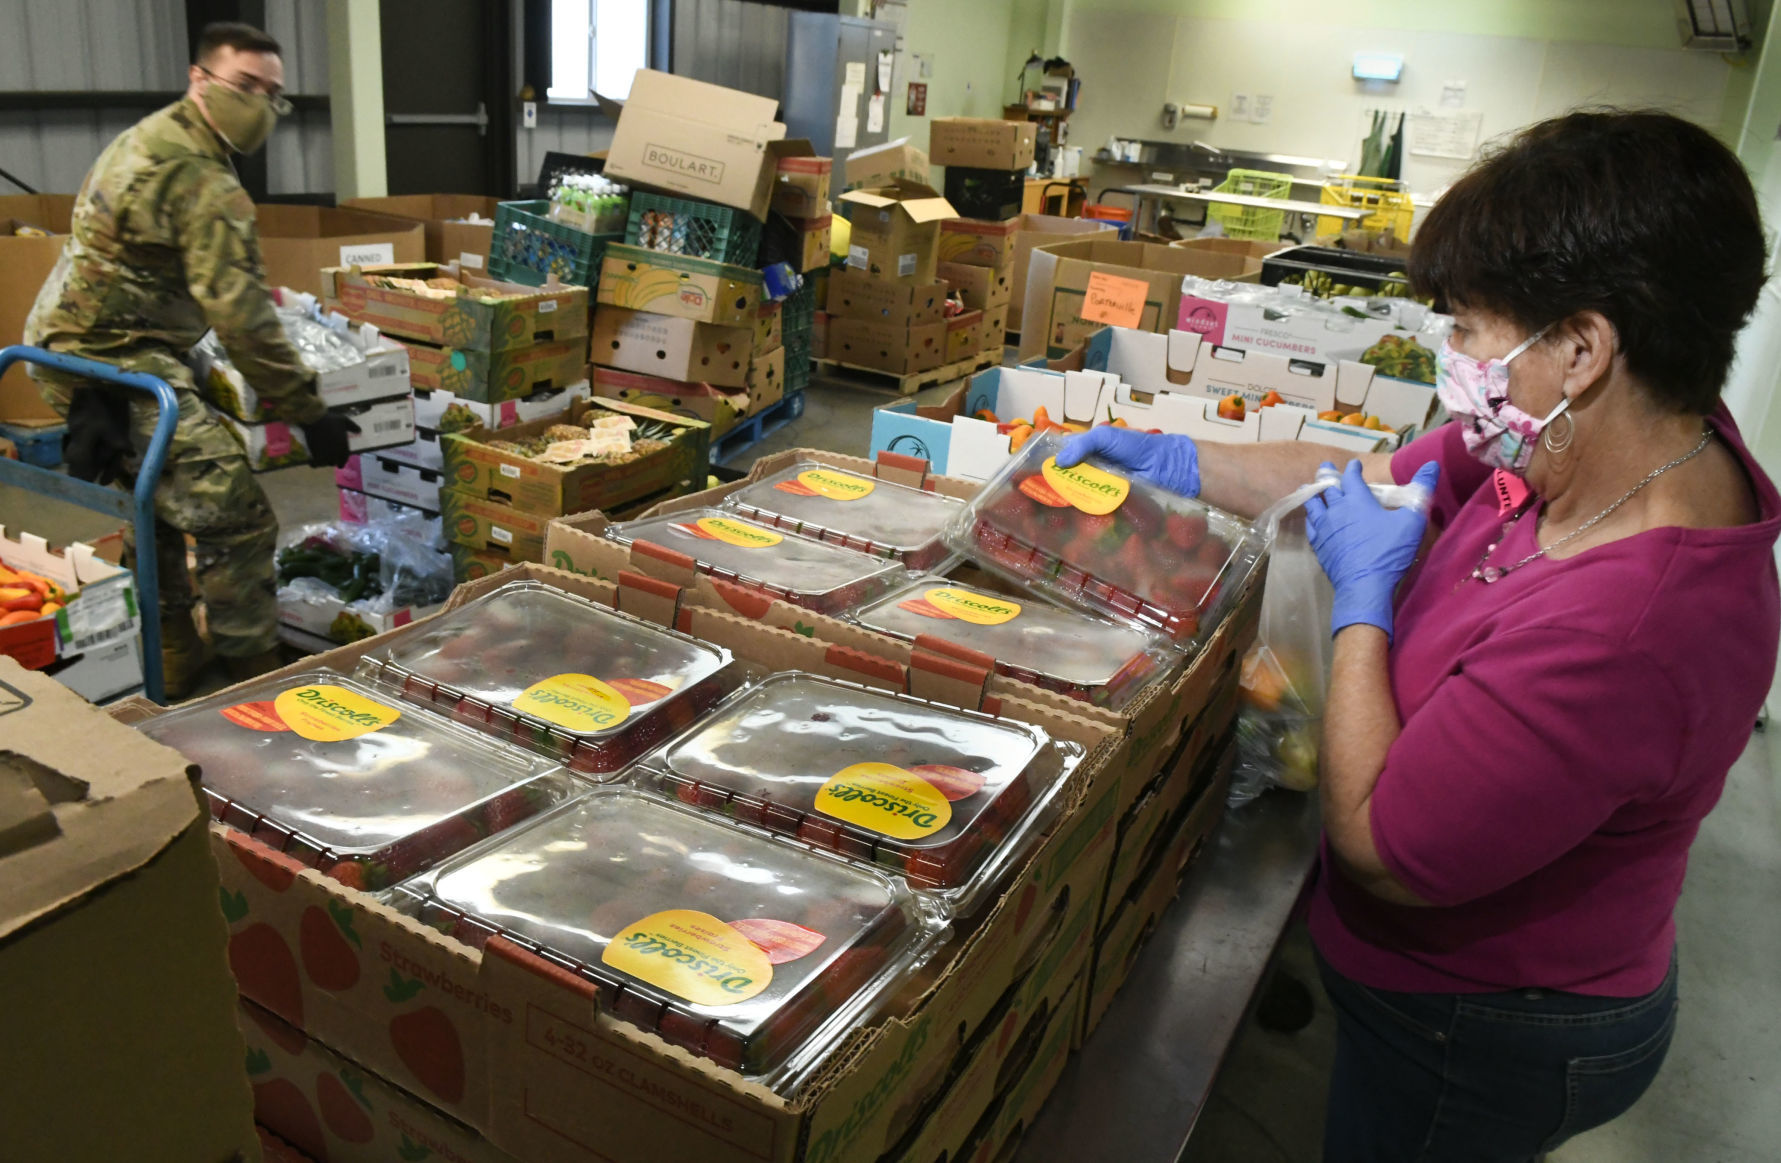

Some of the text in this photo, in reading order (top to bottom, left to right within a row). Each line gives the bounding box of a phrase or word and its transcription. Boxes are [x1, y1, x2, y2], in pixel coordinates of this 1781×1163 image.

[345, 252, 382, 265] CANNED
[1232, 333, 1316, 355] MINI CUCUMBERS
[1206, 384, 1239, 397] SWEET
[1242, 392, 1261, 404] MIN
[296, 688, 382, 727] Driscoll's
[529, 688, 616, 725] Driscoll's
[828, 782, 938, 828] Driscoll's
[669, 923, 730, 952] Strawberries
[625, 931, 753, 994] Driscoll's
[379, 940, 514, 1025] Strawberries
[544, 1027, 589, 1064] 4-32
[617, 1062, 735, 1134] CLAMSHELLS
